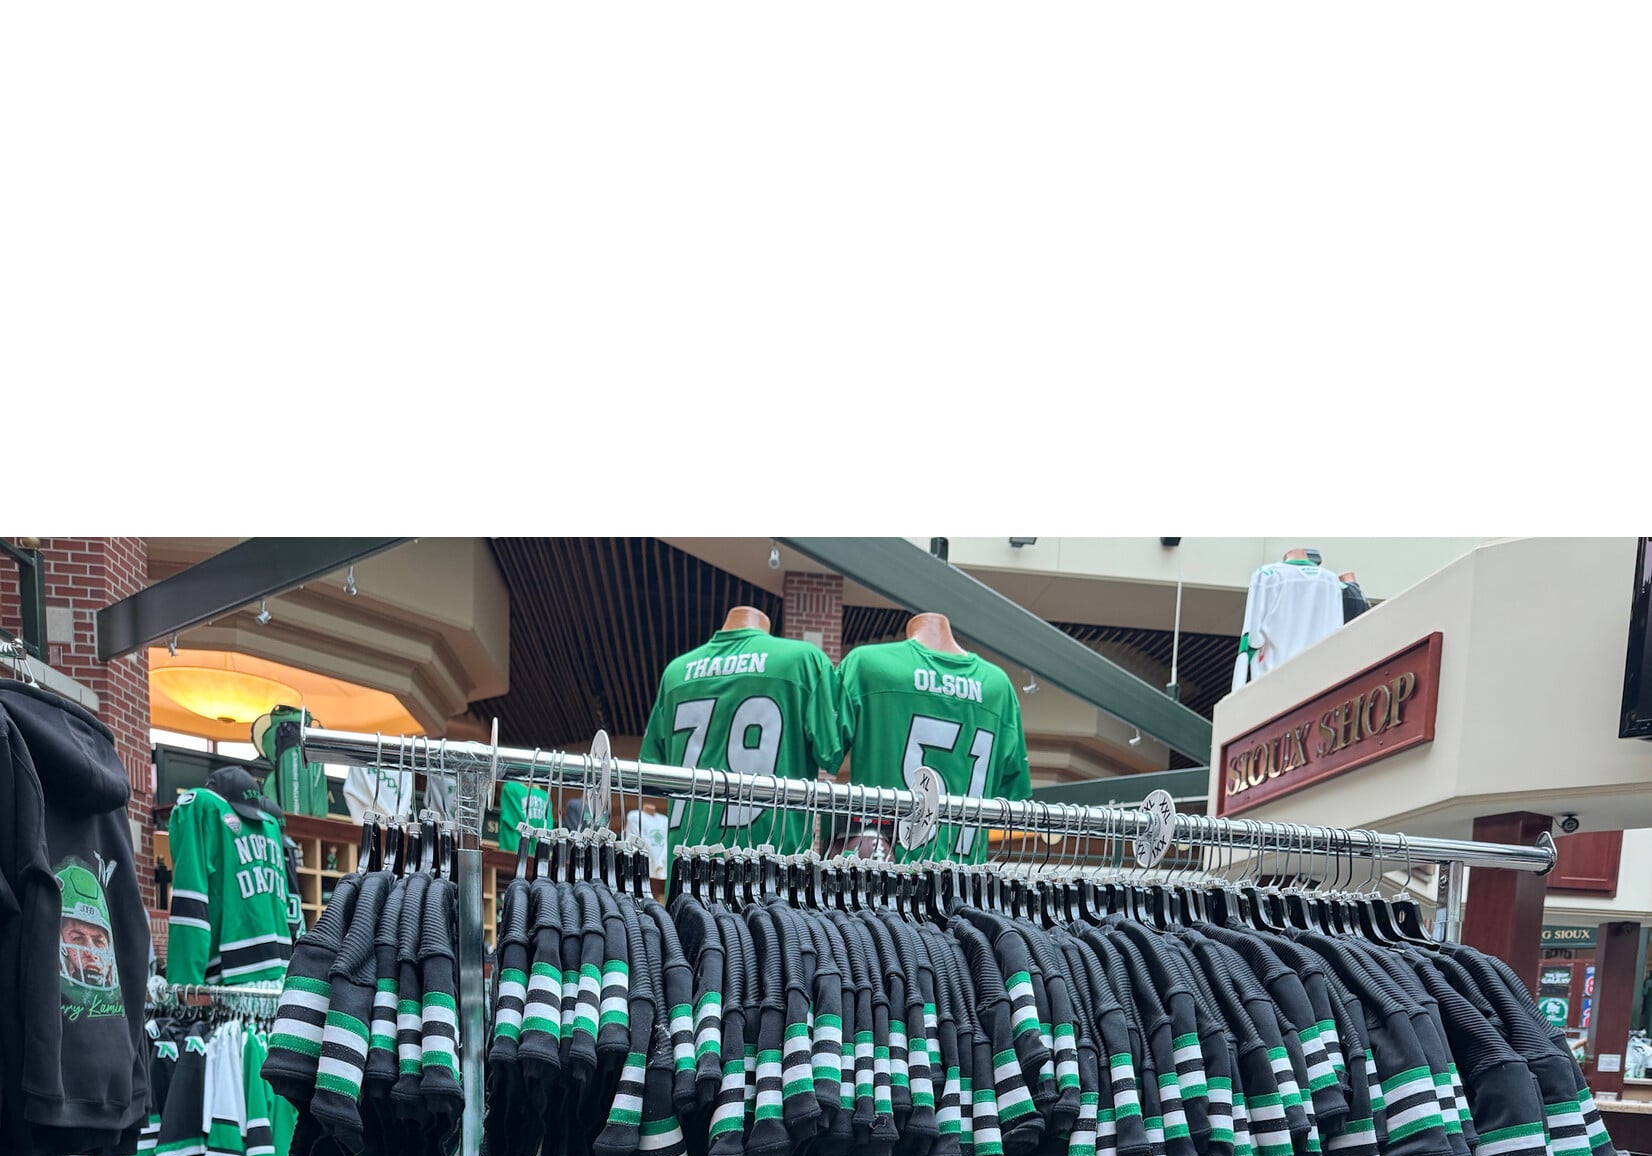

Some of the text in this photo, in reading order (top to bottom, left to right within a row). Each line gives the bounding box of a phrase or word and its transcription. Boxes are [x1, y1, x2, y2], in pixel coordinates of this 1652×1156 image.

[684, 652, 769, 682] THADEN
[913, 668, 984, 703] OLSON
[1225, 671, 1416, 797] SIOUX SHOP
[668, 694, 784, 830] 79
[901, 713, 995, 857] 51
[920, 773, 930, 792] XL
[1554, 929, 1591, 940] SIOUX
